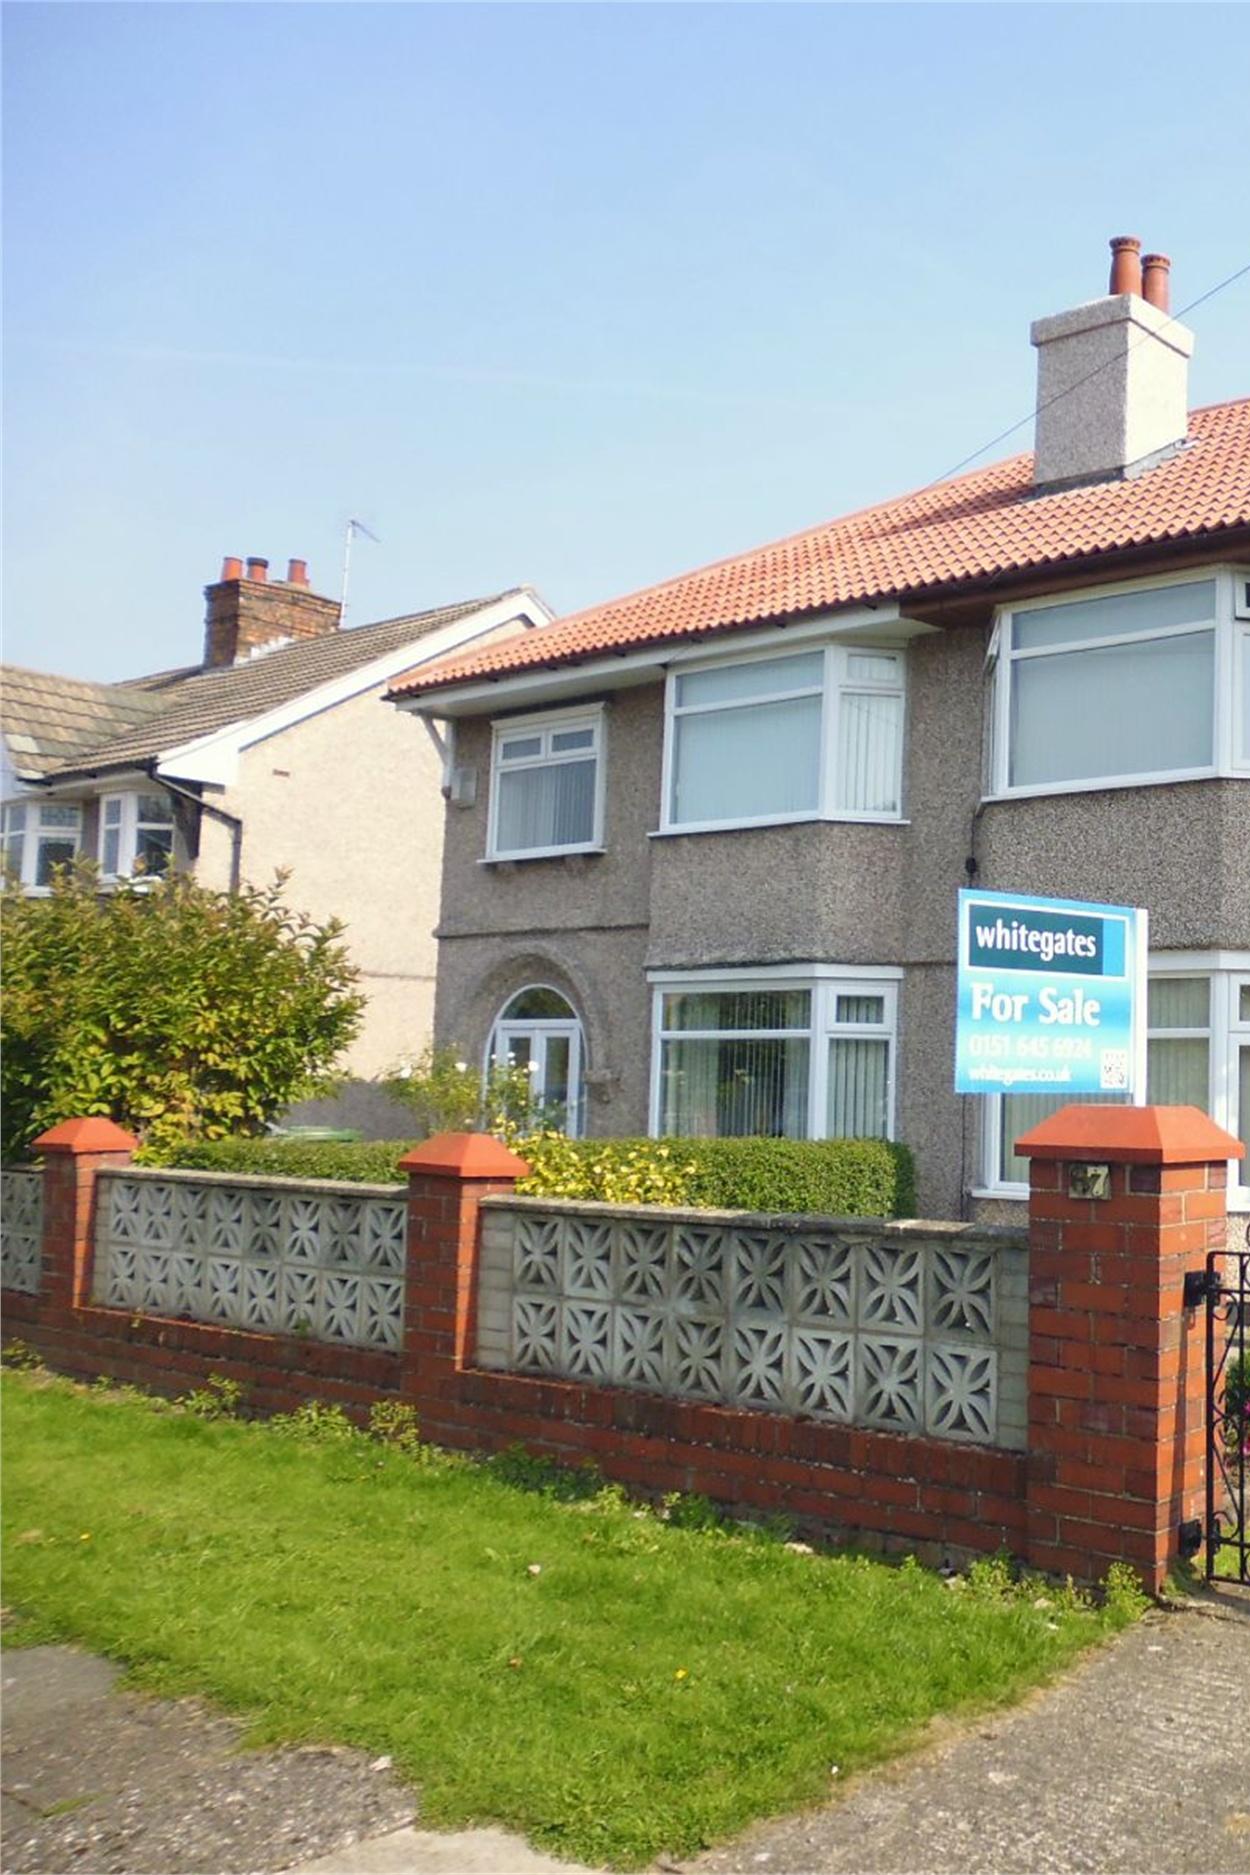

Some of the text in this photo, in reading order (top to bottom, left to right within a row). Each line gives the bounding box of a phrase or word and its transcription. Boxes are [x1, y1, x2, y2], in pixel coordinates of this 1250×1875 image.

[975, 918, 1097, 962] whitegates
[970, 982, 1101, 1027] For Sale
[968, 1034, 1011, 1057] 0151
[1016, 1034, 1049, 1058] 645
